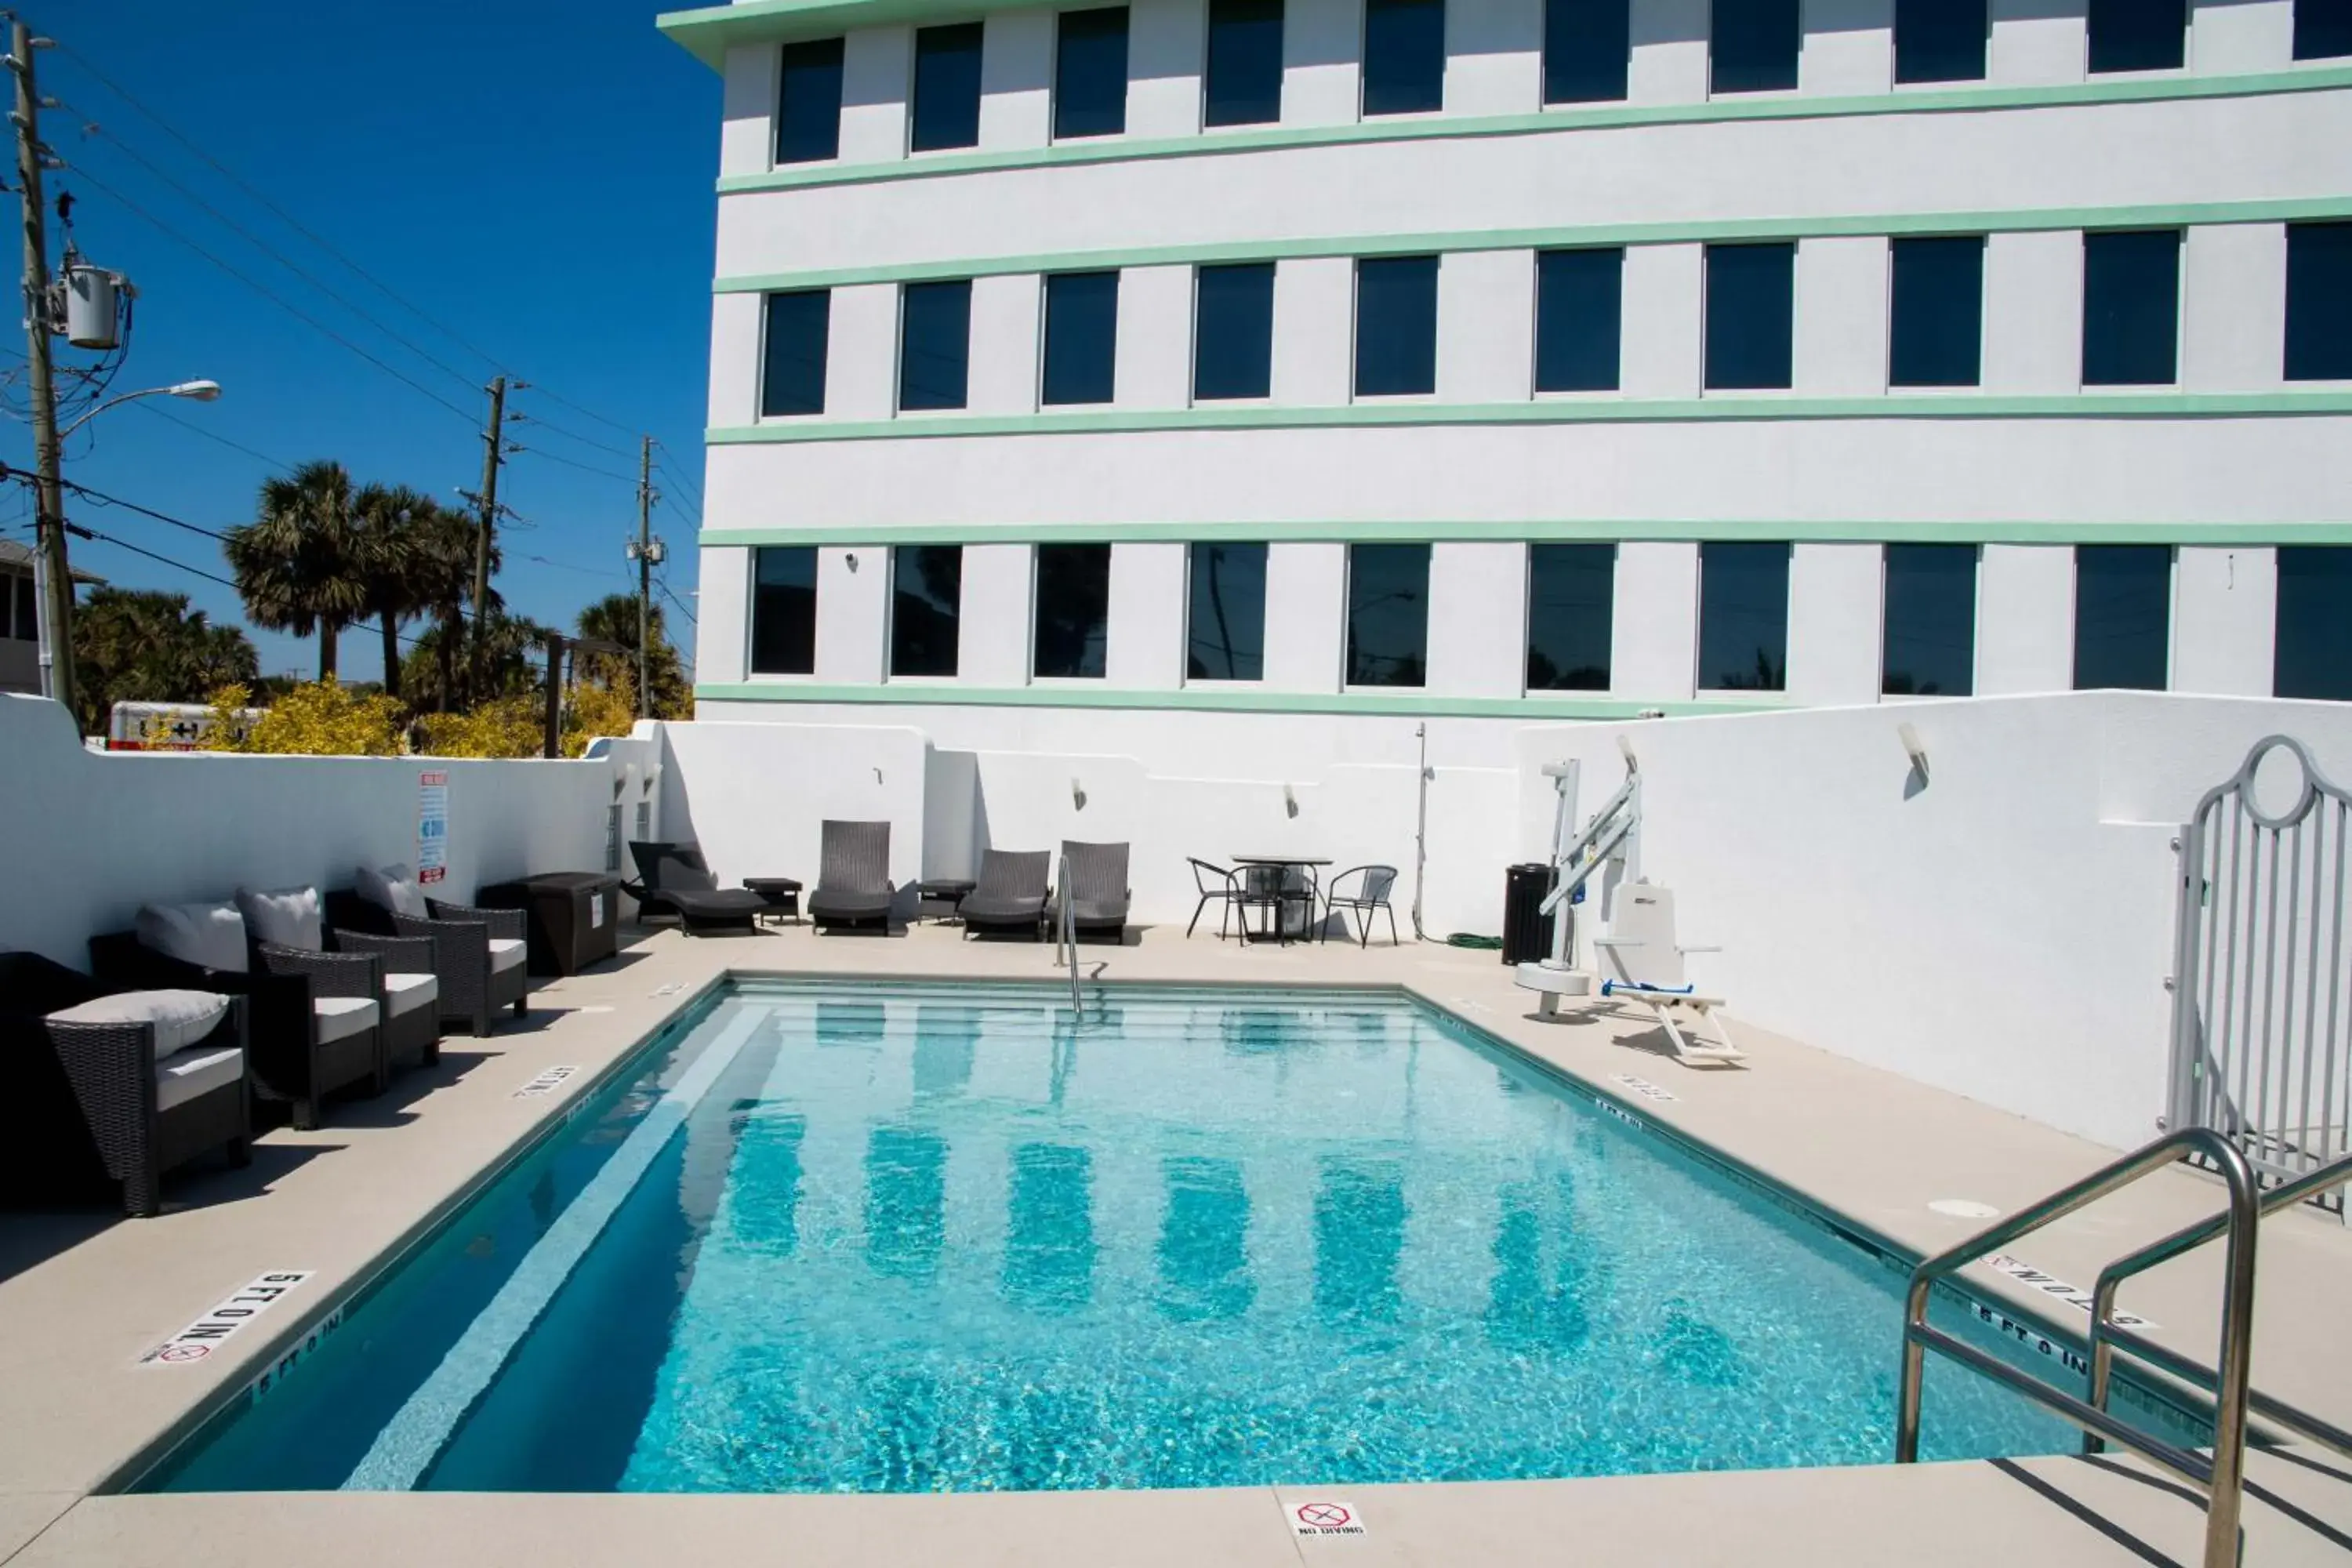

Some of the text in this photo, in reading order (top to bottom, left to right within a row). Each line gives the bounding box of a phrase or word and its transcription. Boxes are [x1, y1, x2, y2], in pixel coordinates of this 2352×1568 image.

[231, 1287, 286, 1302] FT
[278, 1349, 300, 1380] FT
[322, 1313, 339, 1338] IN
[2002, 1318, 2027, 1341] FT
[2063, 1350, 2087, 1375] IN
[1320, 1526, 1364, 1535] DIVING
